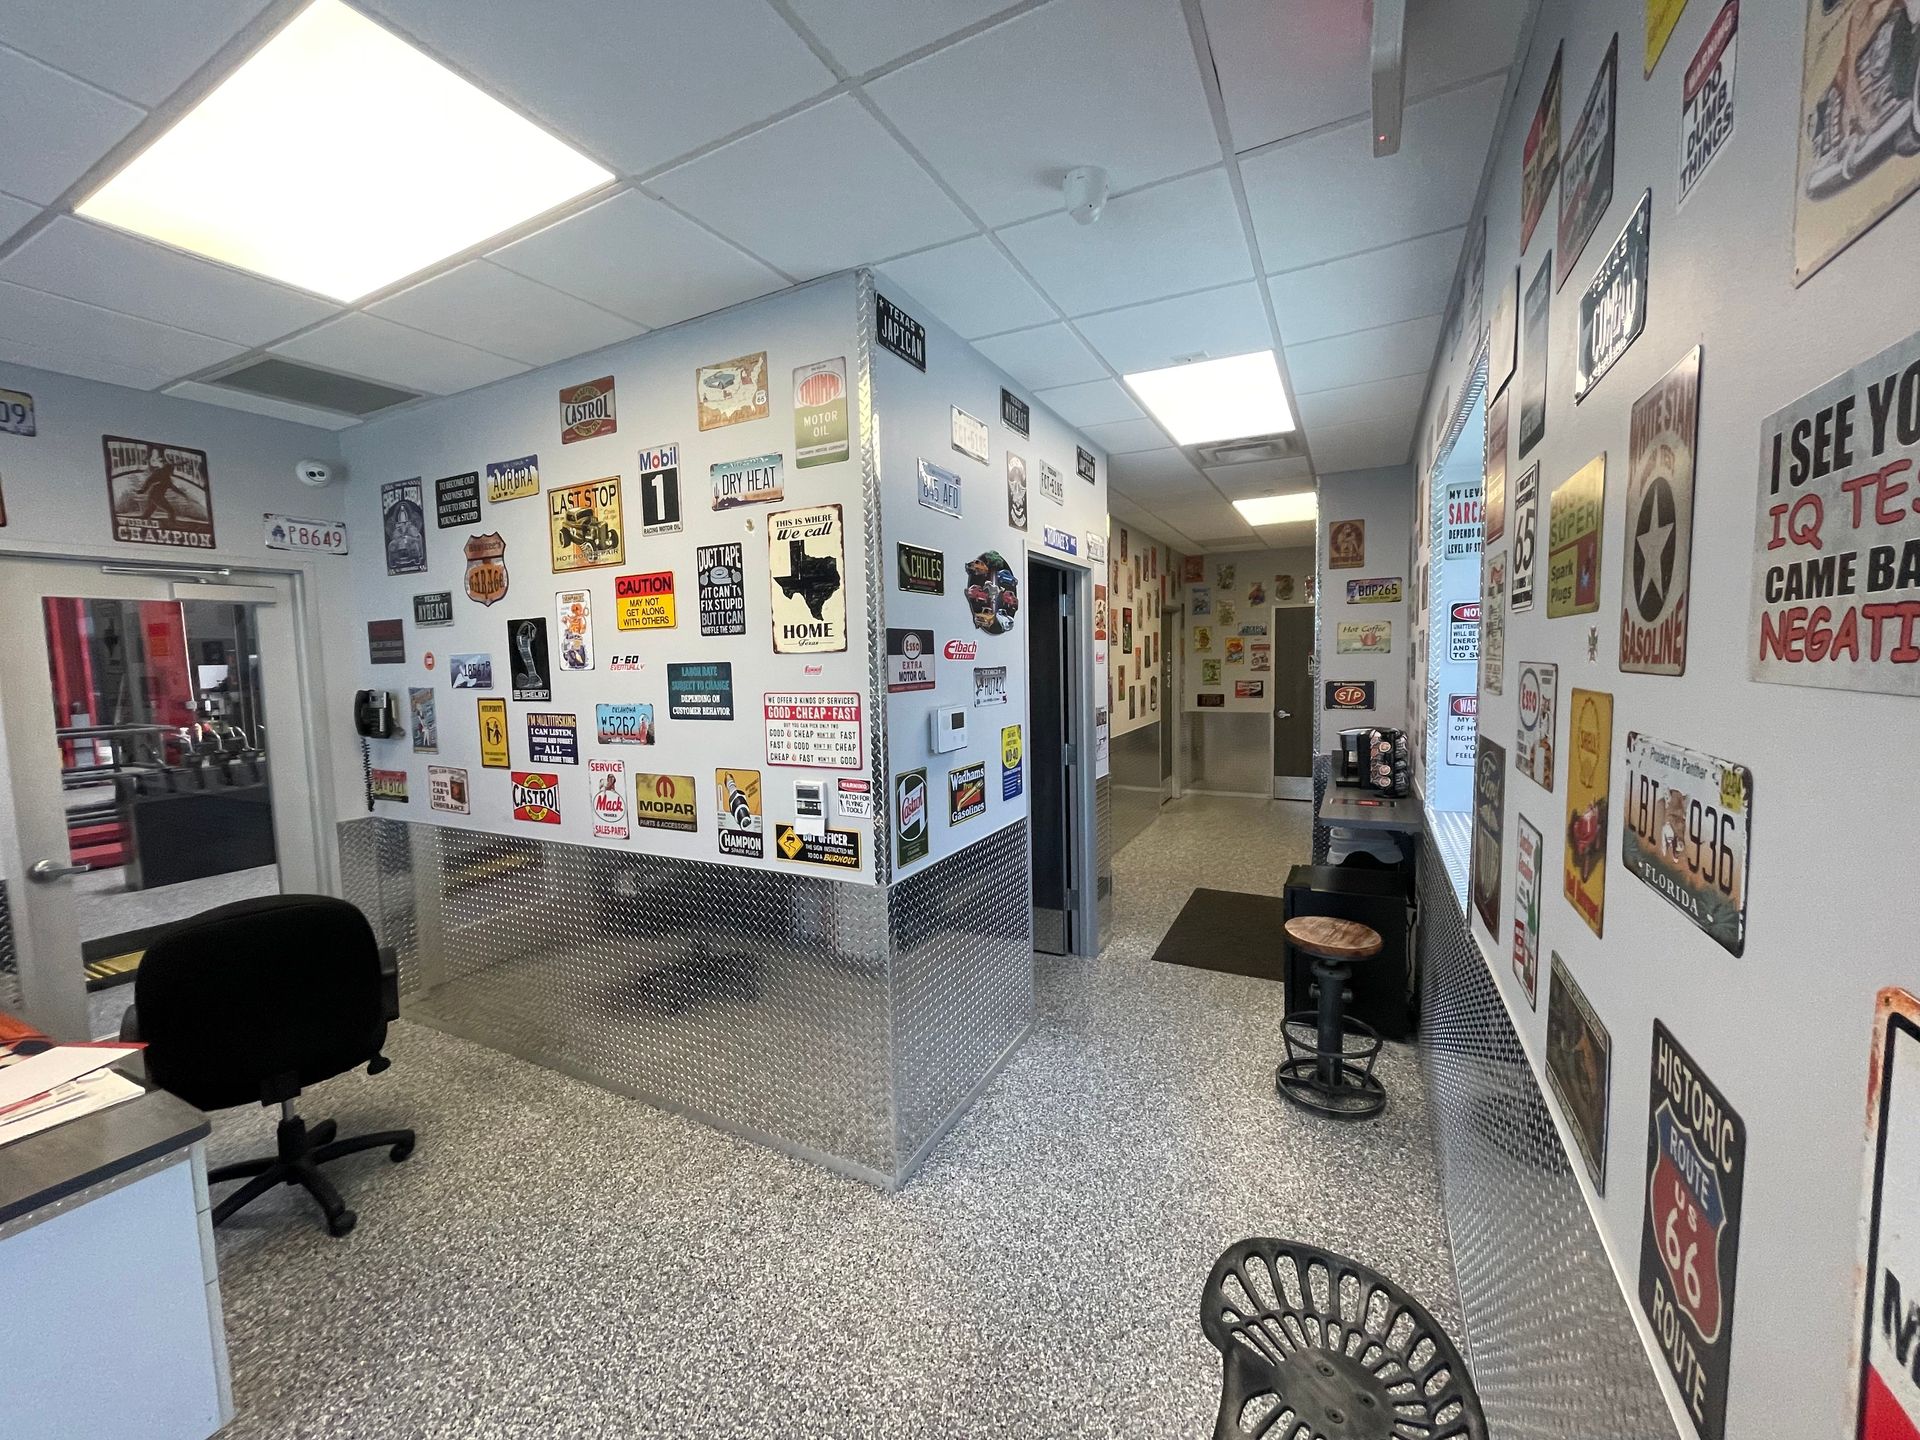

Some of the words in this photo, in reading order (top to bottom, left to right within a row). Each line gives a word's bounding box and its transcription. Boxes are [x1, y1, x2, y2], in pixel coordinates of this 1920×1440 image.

[1693, 98, 1698, 124] I
[1702, 60, 1722, 109] DO
[1687, 79, 1727, 161] DUMB
[1680, 101, 1732, 193] THINGS
[889, 304, 916, 333] TEXAS
[881, 314, 923, 362] JAPICAN
[565, 395, 611, 426] CASTROL
[803, 410, 838, 427] MOTOR
[813, 426, 830, 437] OIL
[1770, 432, 1782, 496] I
[1789, 394, 1856, 488] SEE
[107, 441, 149, 475] HIDE
[150, 448, 163, 468] &
[640, 446, 677, 471] Mobil
[464, 475, 475, 487] OLD
[722, 472, 742, 496] DRY
[747, 466, 776, 492] HEAT
[463, 487, 474, 497] YOU
[551, 488, 581, 515] LAST
[585, 484, 617, 508] STOP
[651, 473, 666, 521] 1
[942, 482, 959, 509] AFD
[1449, 489, 1462, 500] MY
[116, 517, 159, 528] WORLD
[775, 519, 793, 528] THIS
[794, 517, 803, 526] IS
[804, 514, 833, 524] WHERE
[1550, 501, 1596, 548] SUPER
[1767, 493, 1824, 551] IQ
[117, 526, 212, 547] CHAMPION
[643, 526, 659, 535] RACING
[659, 525, 674, 533] MOTOR
[673, 523, 681, 531] OIL
[776, 529, 801, 540] We
[804, 521, 833, 538] call
[1448, 527, 1475, 540] DEPENDS
[299, 527, 342, 548] 8649
[1514, 508, 1536, 575] 65
[1447, 543, 1464, 554] LEVEL
[1465, 542, 1473, 553] OF
[556, 554, 572, 562] HOT
[698, 547, 718, 573] DUCT
[718, 545, 742, 569] TAPE
[911, 554, 942, 582] CHILES
[1550, 559, 1574, 582] Spark
[617, 575, 672, 595] CAUTION
[1765, 551, 1857, 604] CAME
[713, 584, 737, 598] CAN'T
[1550, 587, 1573, 605] Plugs
[629, 599, 643, 607] MAY
[645, 597, 660, 606] NOT
[700, 599, 714, 612] FIX
[714, 597, 743, 611] STUPID
[626, 608, 640, 617] GET
[641, 606, 665, 616] ALONG
[701, 612, 717, 626] BUT
[717, 611, 726, 625] IT
[725, 610, 744, 624] CAN
[623, 617, 641, 626] WITH
[641, 615, 670, 626] OTHERS
[783, 623, 835, 639] HOME
[1342, 625, 1359, 633] Hot
[1361, 624, 1386, 635] Coffee
[1622, 591, 1686, 666] GASOLINE
[1759, 600, 1920, 664] NEGATI
[905, 640, 920, 652] Esso
[943, 639, 977, 660] Eibach
[902, 661, 923, 670] EXTRA
[899, 671, 918, 682] MOTOR
[917, 670, 927, 681] OIL
[695, 680, 705, 691] TO
[704, 680, 730, 691] CHANGE
[521, 690, 549, 699] SHELBY
[680, 694, 712, 703] DEPENDING
[711, 694, 721, 703] ON
[776, 696, 793, 704] OFFER
[826, 697, 855, 705] SERVICES
[1338, 688, 1362, 701] STP
[1521, 683, 1537, 713] Esso
[611, 706, 637, 714] OKLAHOMA
[672, 706, 702, 715] CUSTOMER
[702, 706, 731, 716] BEHAVIOR
[768, 706, 791, 719] GOOD
[795, 707, 827, 720] CHEAP
[832, 707, 857, 720] FAST
[536, 715, 576, 728] MULTITASKING
[609, 716, 636, 736] 5262
[535, 727, 549, 736] CAN
[549, 728, 574, 738] LISTEN,
[769, 728, 785, 737] GOOD
[793, 730, 815, 738] CHEAP
[840, 731, 857, 740] FAST
[544, 745, 563, 754] ALL
[769, 740, 784, 749] FAST
[793, 741, 810, 750] GOOD
[835, 743, 857, 752] CHEAP
[770, 753, 790, 761] CHEAP
[799, 753, 814, 763] FAST
[840, 756, 857, 766] GOOD
[1650, 746, 1671, 766] Protect
[1670, 754, 1681, 770] the
[1681, 757, 1708, 780] Panther
[590, 763, 623, 773] SERVICE
[431, 780, 449, 788] YOUR
[841, 782, 868, 791] WARNING
[950, 767, 985, 791] Wadhams
[432, 794, 446, 802] LIFE
[513, 783, 560, 813] CASTROL
[595, 794, 624, 812] Mack
[839, 793, 859, 801] WATCH
[845, 800, 864, 808] FLYING
[433, 801, 465, 812] INSURANCE
[639, 800, 695, 815] MOPAR
[845, 806, 864, 814] TOOLS
[901, 786, 924, 826] Castrol
[951, 802, 985, 822] Gasolines
[640, 819, 656, 827] PARTS
[661, 820, 696, 830] ACCESSORIES
[719, 829, 761, 852] CHAMPION
[1687, 798, 1735, 896] 936
[730, 847, 746, 855] SPARK
[745, 848, 760, 856] PLUGS
[823, 845, 847, 855] INSTRUCTED
[823, 853, 857, 865] BURNOUT
[1644, 862, 1700, 917] FLORIDA
[1657, 1036, 1735, 1175] HISTORIC
[1669, 1124, 1710, 1211] ROUTE
[1664, 1208, 1702, 1309] 66
[1651, 1277, 1708, 1424] ROUTE
